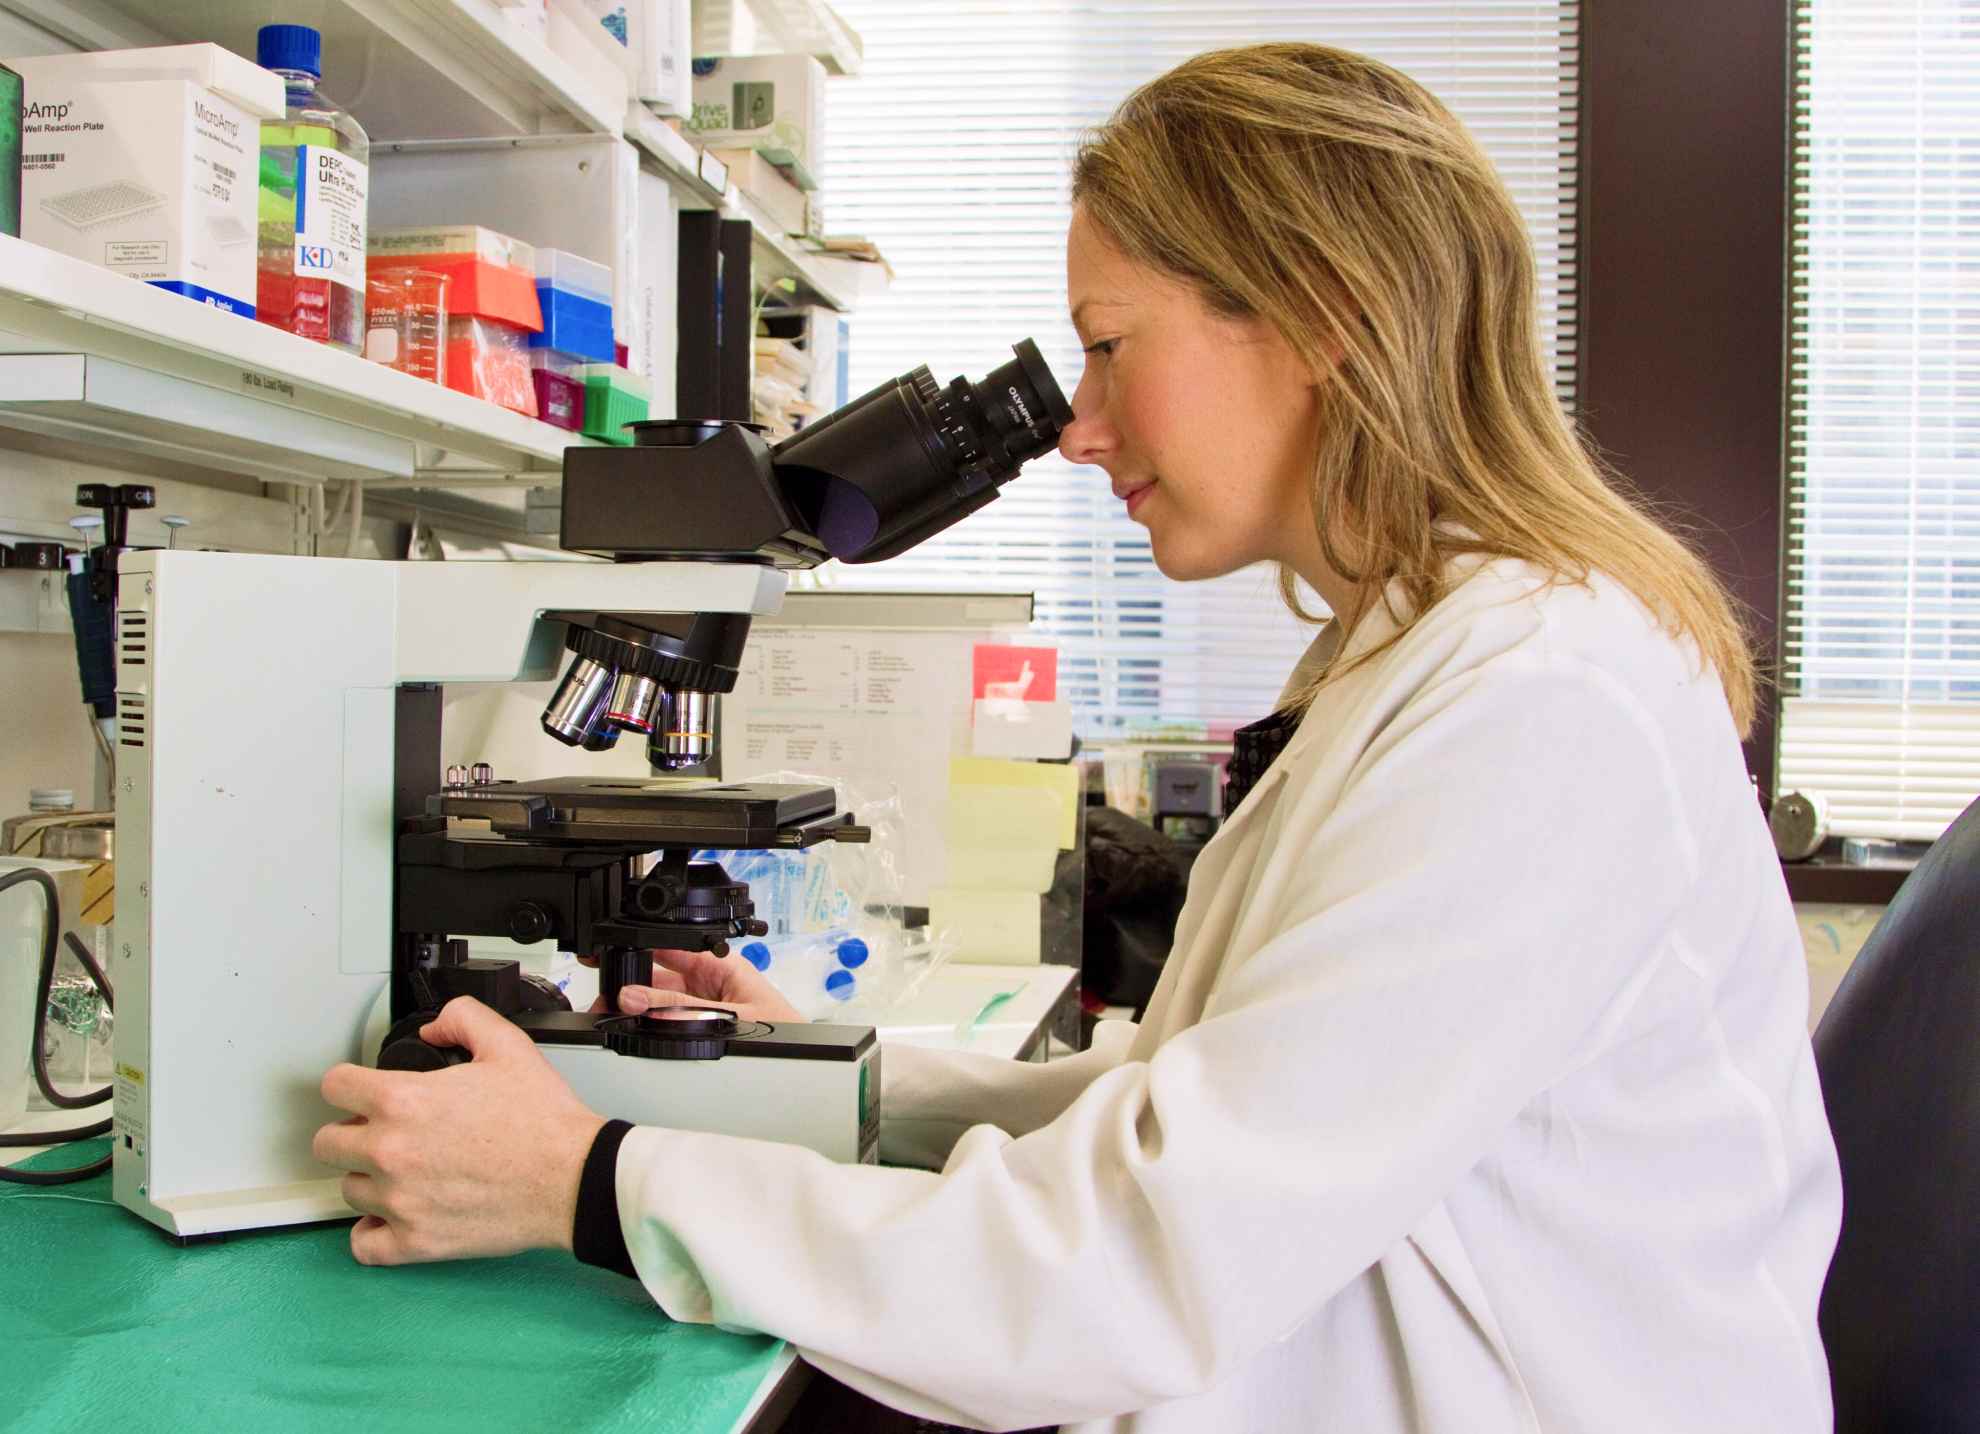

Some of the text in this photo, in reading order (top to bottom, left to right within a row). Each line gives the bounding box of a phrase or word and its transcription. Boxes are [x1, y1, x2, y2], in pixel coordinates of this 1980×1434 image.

[44, 123, 81, 132] Reaction
[83, 121, 105, 131] Plate
[1009, 386, 1035, 428] OLYMPUS
[39, 553, 47, 566] 3
